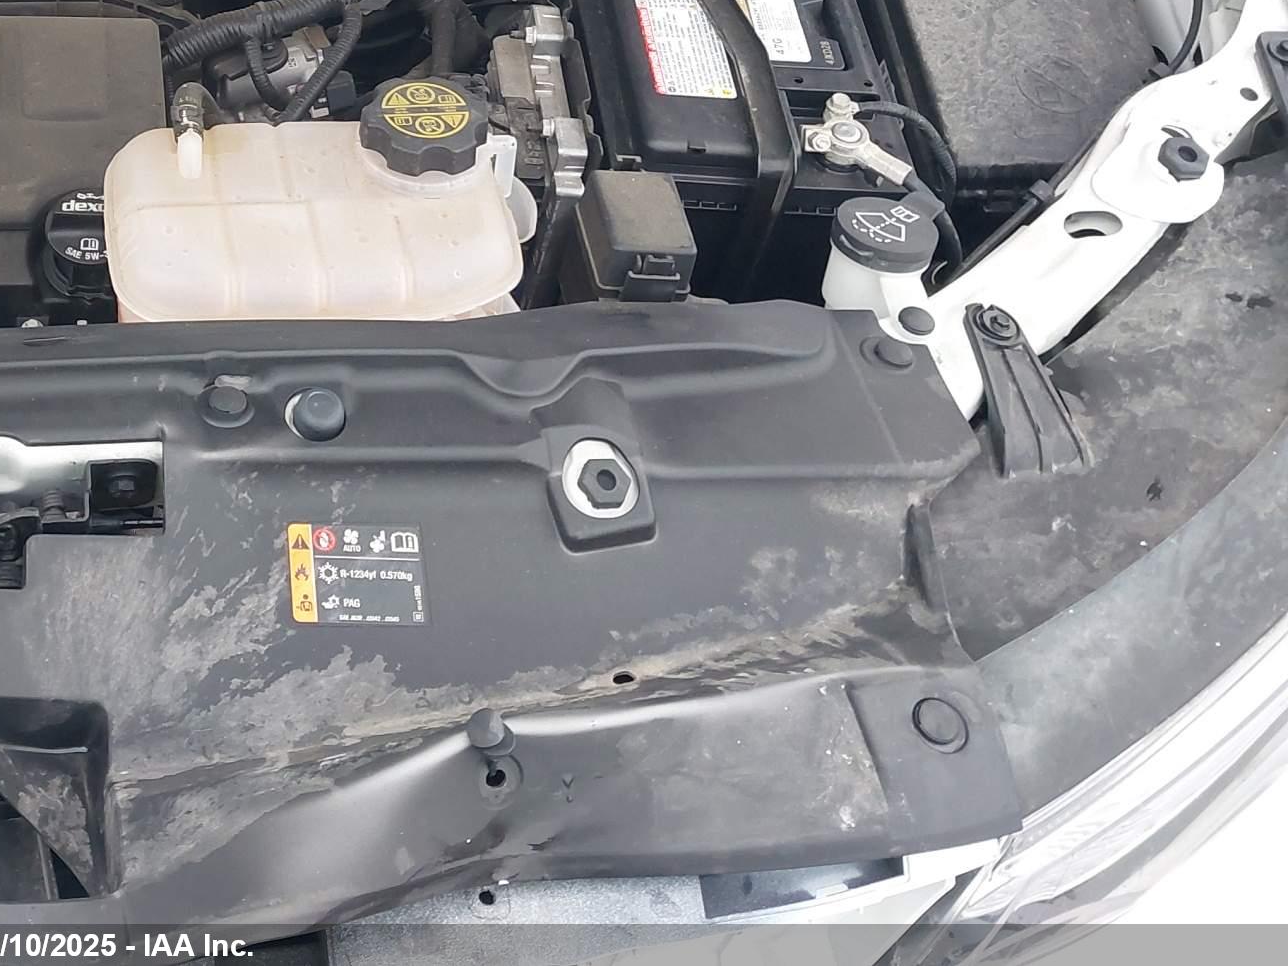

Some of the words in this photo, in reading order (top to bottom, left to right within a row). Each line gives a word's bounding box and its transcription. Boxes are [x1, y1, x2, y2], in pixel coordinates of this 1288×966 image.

[64, 246, 82, 260] SAE
[343, 545, 361, 553] AUTO
[343, 598, 361, 608] PAG
